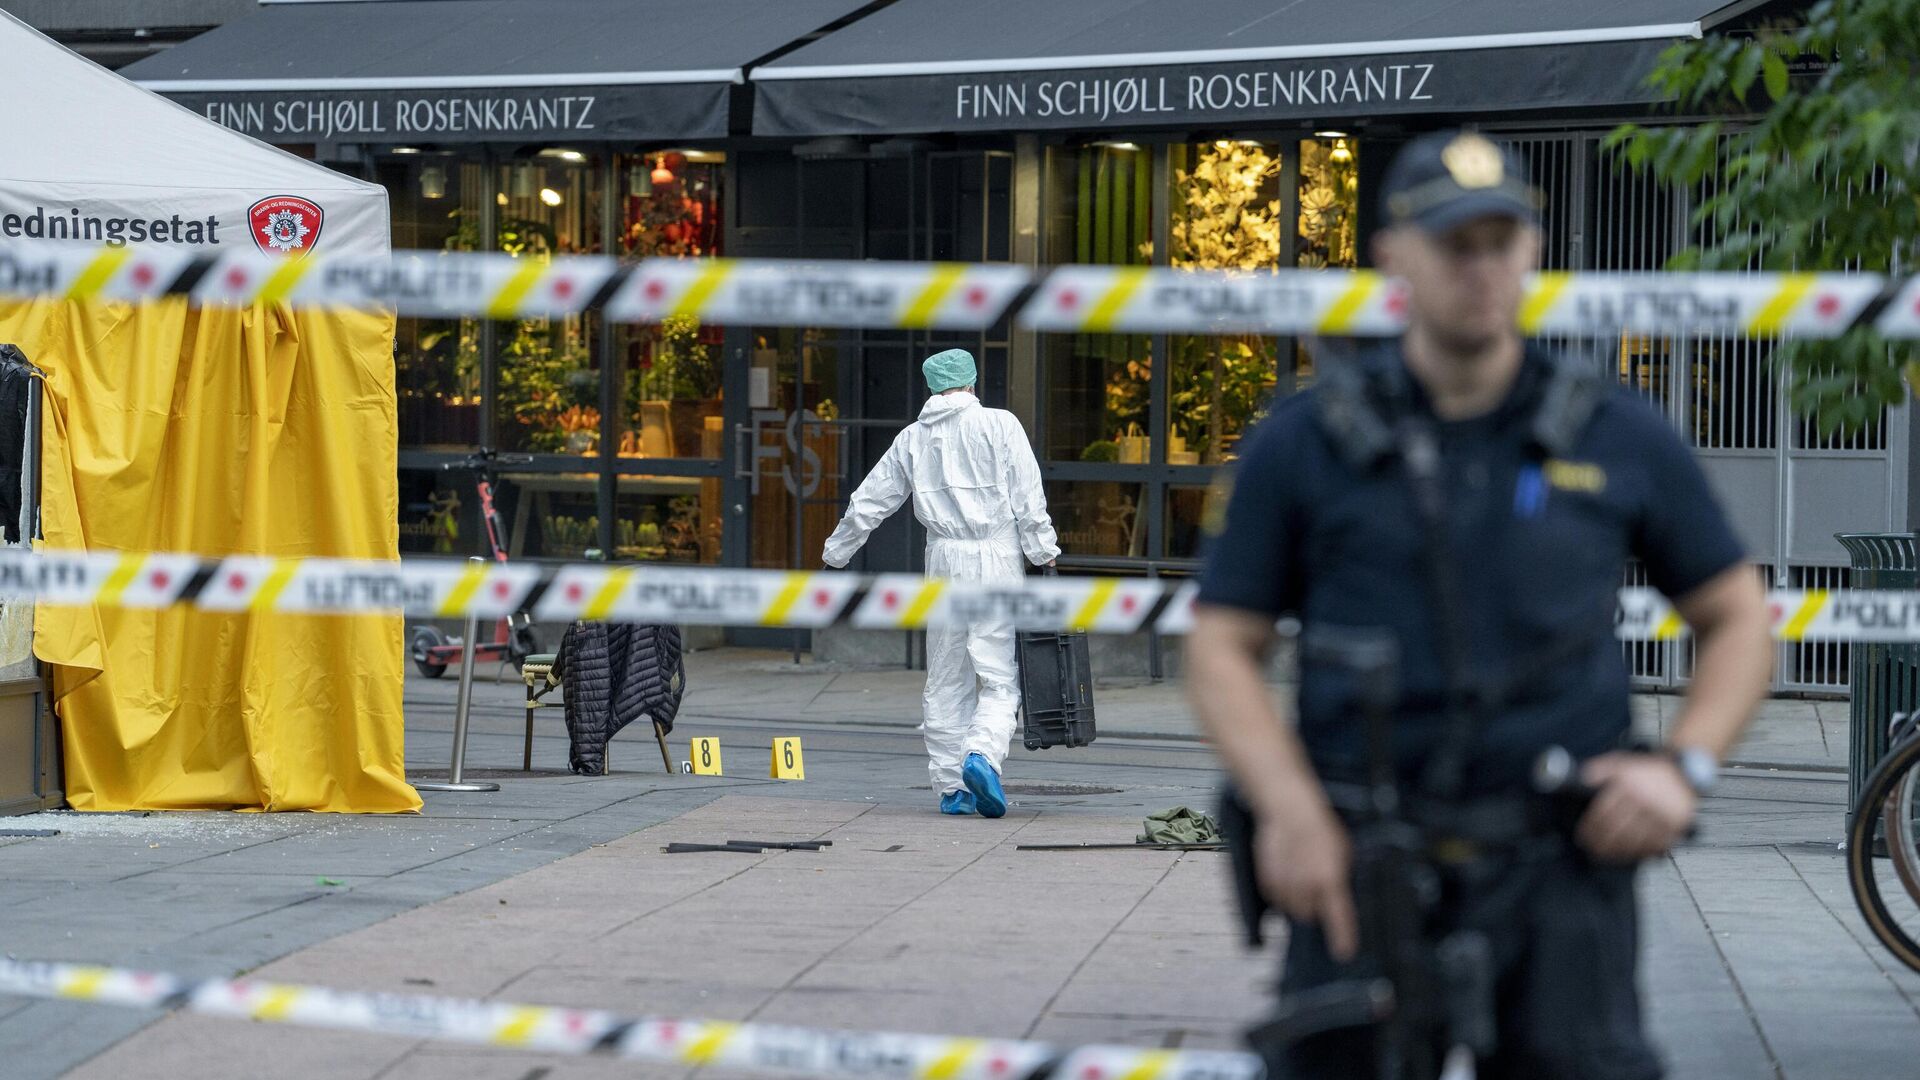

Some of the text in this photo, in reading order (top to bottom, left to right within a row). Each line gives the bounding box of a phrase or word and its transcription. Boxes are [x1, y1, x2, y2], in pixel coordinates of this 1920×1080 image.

[957, 64, 1434, 121] FINN SCHJØLL ROSENKRANTZ
[206, 97, 595, 139] FINN SCHJØLL ROSENKRANTZ
[2, 206, 220, 248] edningsetat
[701, 739, 712, 768] 8
[783, 740, 794, 769] 6
